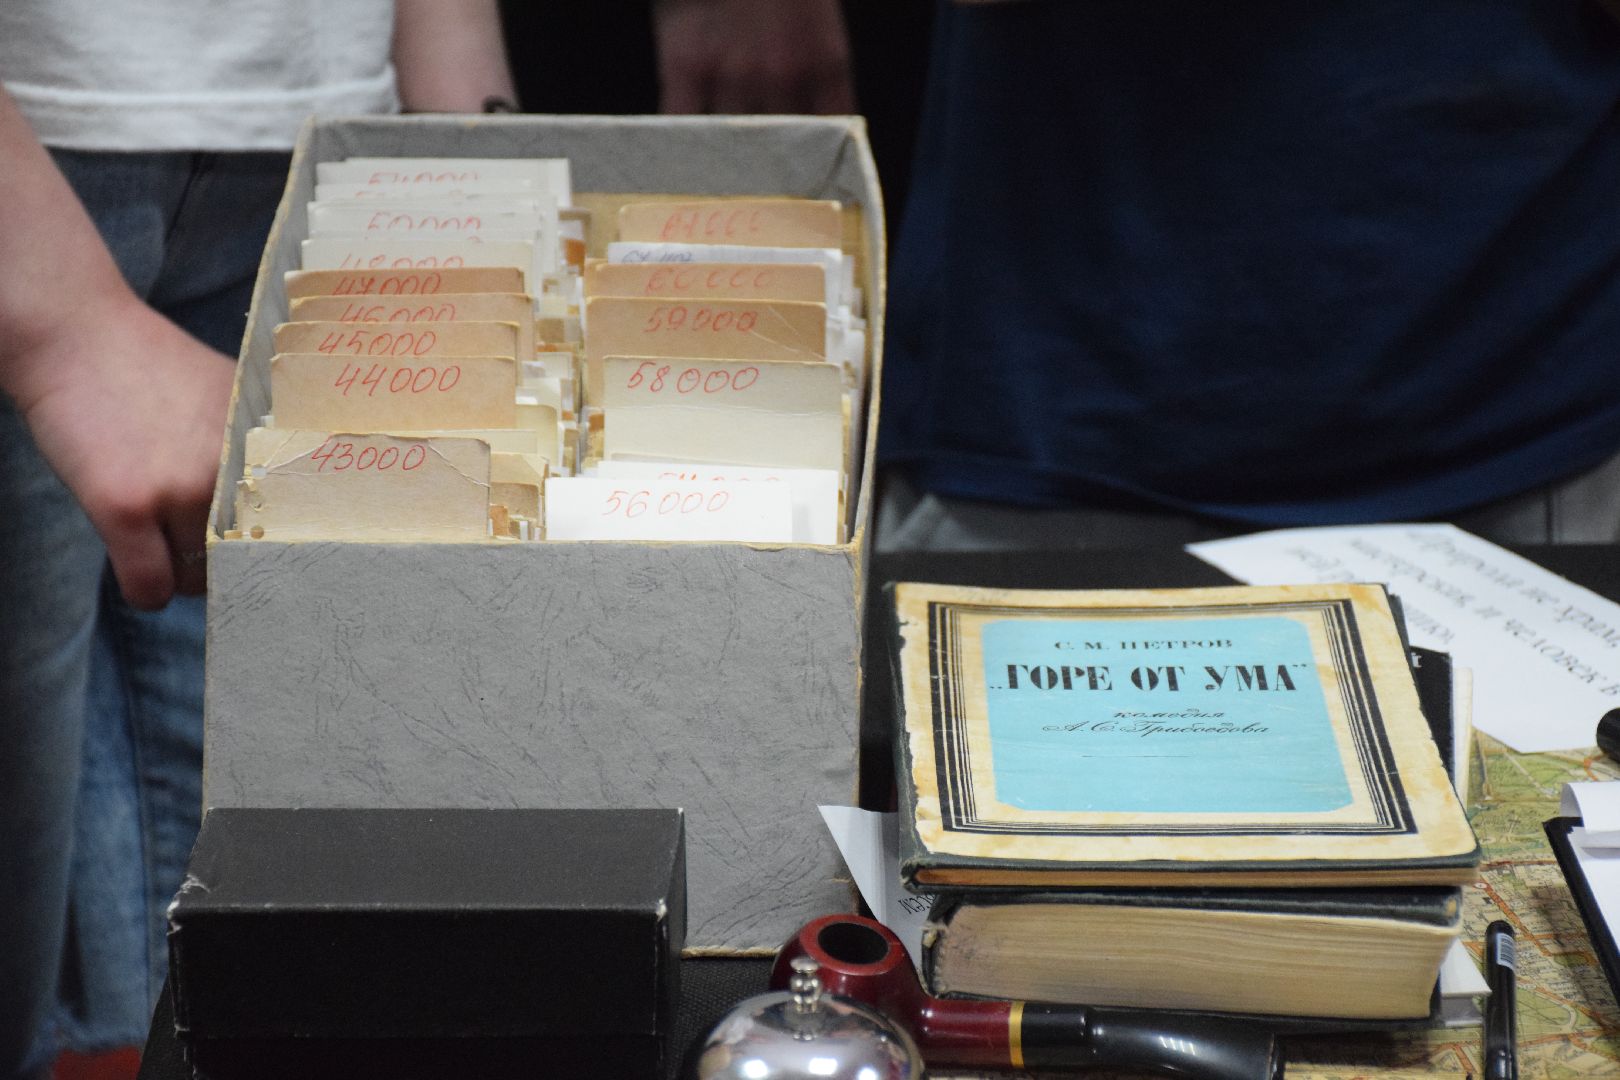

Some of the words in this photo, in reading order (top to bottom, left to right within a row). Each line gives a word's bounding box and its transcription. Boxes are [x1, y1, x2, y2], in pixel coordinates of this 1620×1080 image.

[339, 303, 456, 322] 46000
[318, 331, 436, 355] 45000
[335, 364, 461, 396] 44000
[627, 361, 760, 393] 58000
[311, 434, 426, 472] 43000
[602, 490, 729, 518] 56000
[1083, 640, 1111, 651] М.
[1119, 638, 1233, 651] ПЕТРОВ
[1130, 665, 1186, 692] ОТ
[1113, 708, 1225, 719] комедия
[1119, 719, 1270, 738] Грибоедова
